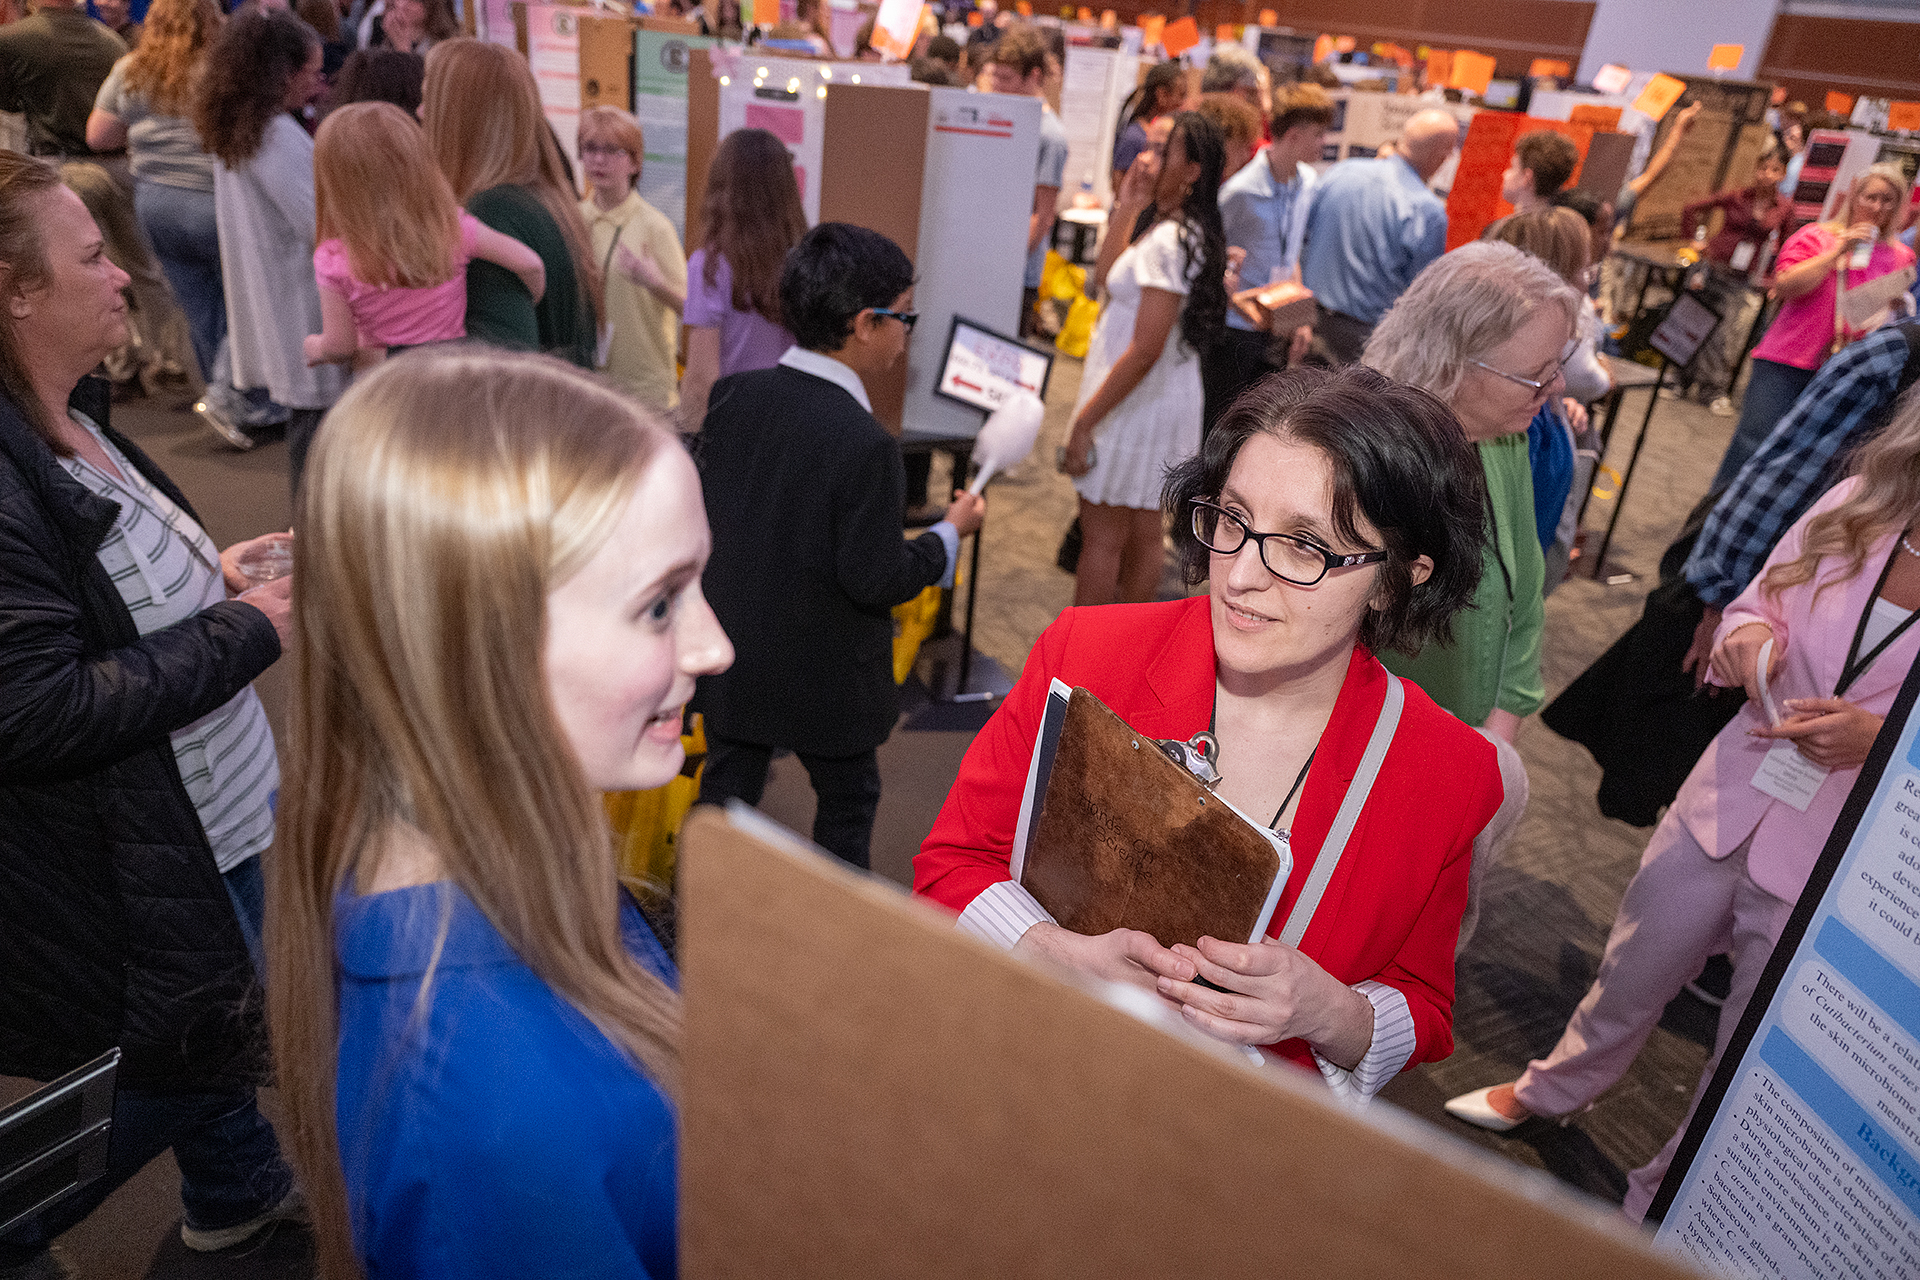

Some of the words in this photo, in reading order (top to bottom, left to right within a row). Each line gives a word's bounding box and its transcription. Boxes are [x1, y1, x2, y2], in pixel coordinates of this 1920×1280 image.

[1096, 825, 1155, 888] Science
[1899, 824, 1910, 839] is
[1861, 871, 1920, 919] experience
[1868, 898, 1878, 911] it
[1879, 909, 1912, 938] could
[1802, 984, 1816, 997] of
[1815, 995, 1888, 1063] Cutibacterium
[1888, 1063, 1920, 1093] acnes
[1816, 969, 1845, 1001] There
[1847, 1000, 1868, 1021] will
[1868, 1016, 1882, 1034] be
[1882, 1033, 1890, 1043] a
[1809, 1012, 1827, 1031] the
[1828, 1030, 1850, 1053] skin
[1851, 1051, 1916, 1115] microbiome
[1714, 1171, 1757, 1228] bacterium.
[1740, 1118, 1773, 1159] During
[1773, 1156, 1830, 1223] adolescence,
[1833, 1220, 1851, 1242] the
[1851, 1241, 1874, 1269] skin
[1745, 1106, 1809, 1172] physiological
[1807, 1171, 1879, 1251] characteristics
[1881, 1250, 1897, 1265] of
[1894, 1265, 1911, 1280] th
[1753, 1091, 1773, 1115] skin
[1774, 1113, 1832, 1176] microbiome
[1832, 1172, 1842, 1187] is
[1843, 1185, 1898, 1247] dependent
[1762, 1075, 1780, 1099] The
[1780, 1098, 1841, 1163] composition
[1842, 1161, 1857, 1175] of
[1855, 1174, 1908, 1232] microbial
[1694, 1211, 1716, 1239] Acne
[1715, 1236, 1724, 1249] is
[1724, 1248, 1747, 1276] most
[1701, 1198, 1725, 1230] where
[1726, 1230, 1737, 1243] C.
[1737, 1244, 1762, 1274] acnes
[1706, 1184, 1751, 1239] Sebaceous
[1749, 1239, 1780, 1275] glands
[1720, 1160, 1731, 1174] C.
[1730, 1174, 1756, 1202] acnes
[1755, 1200, 1764, 1213] is
[1765, 1212, 1772, 1221] a
[1771, 1221, 1829, 1280] gram-positi
[1725, 1146, 1761, 1187] suitable
[1761, 1185, 1820, 1255] environment
[1820, 1252, 1838, 1273] for
[1732, 1133, 1739, 1143] a
[1740, 1141, 1764, 1170] shift;
[1763, 1167, 1789, 1197] more
[1789, 1196, 1821, 1233] sebum
[1821, 1230, 1832, 1244] is
[1831, 1244, 1867, 1280] produ
